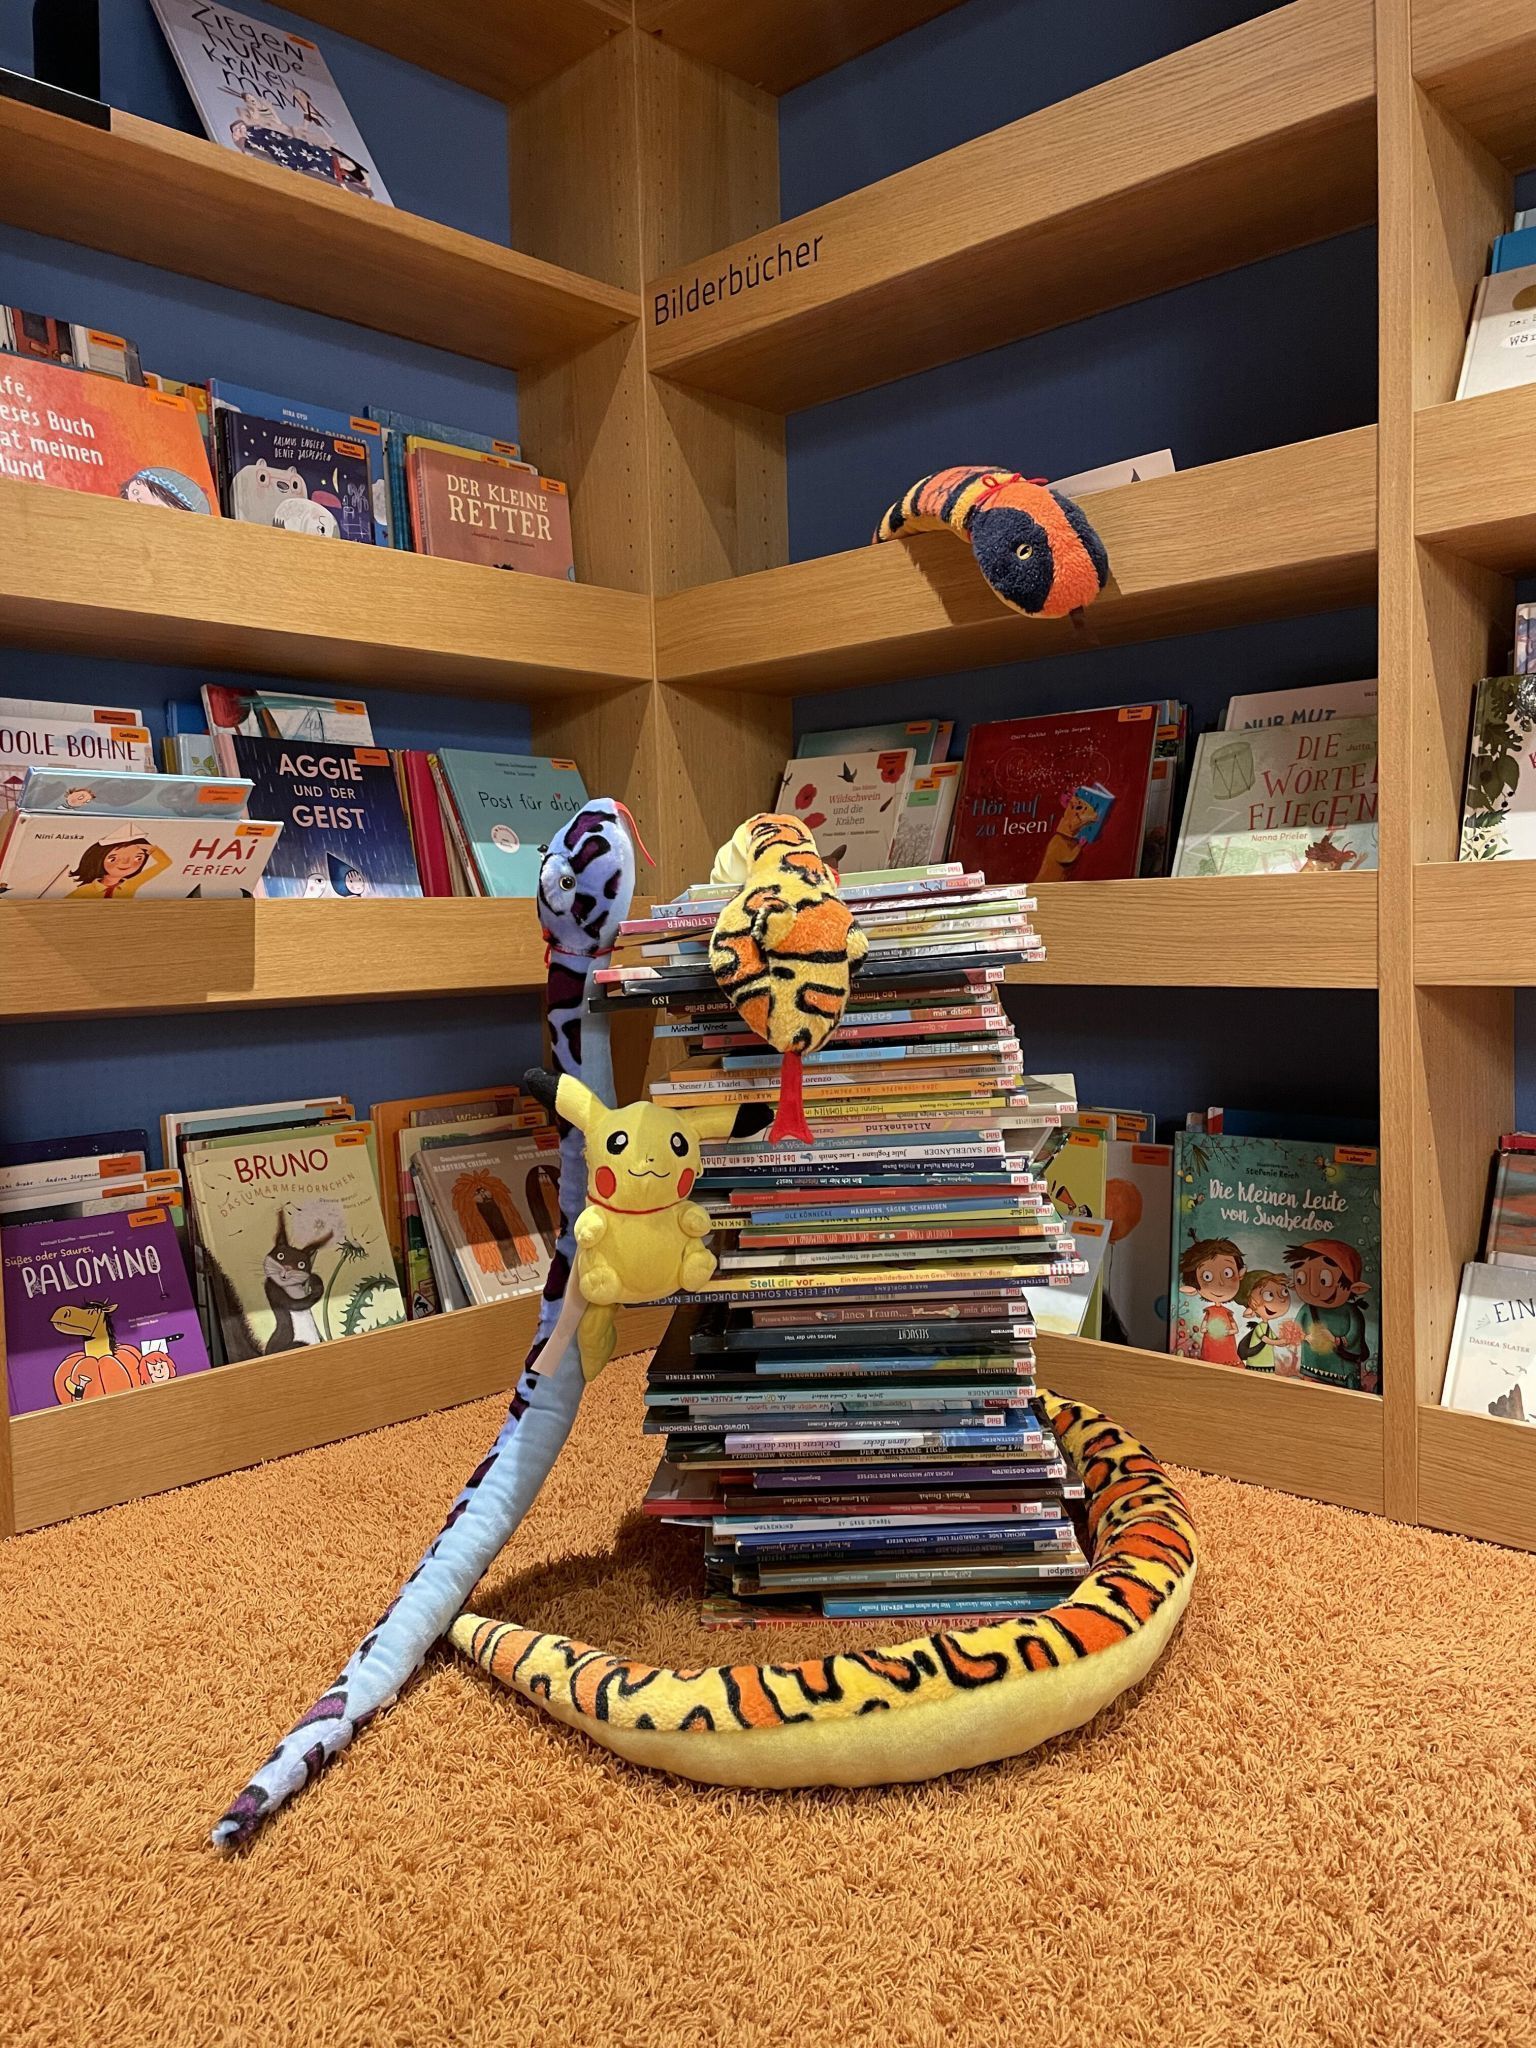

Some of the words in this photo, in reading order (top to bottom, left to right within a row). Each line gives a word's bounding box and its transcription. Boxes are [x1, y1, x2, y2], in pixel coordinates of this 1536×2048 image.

[655, 234, 824, 326] Bilderbücher
[47, 410, 96, 439] Buch
[0, 429, 23, 450] at
[30, 436, 104, 466] meinen
[273, 434, 297, 448] RASMUS
[301, 437, 326, 451] ENGLER
[297, 447, 333, 463] JASPERSEN
[446, 473, 481, 498] DER
[487, 483, 549, 513] KLEINE
[448, 493, 553, 542] RETTER
[1290, 708, 1336, 726] MUT
[66, 733, 142, 762] BOHNE
[1297, 733, 1342, 761] DIE
[278, 752, 364, 782] AGGIE
[292, 783, 324, 798] UND
[329, 785, 357, 800] DER
[478, 791, 514, 810] Post
[519, 792, 543, 811] für
[550, 792, 581, 812] dich
[828, 792, 881, 805] Wildschwein
[832, 804, 850, 815] und
[849, 804, 863, 815] die
[972, 797, 1007, 817] Hör
[1012, 793, 1041, 819] auf
[1247, 791, 1378, 832] FLIEGEN
[291, 804, 365, 831] GEIST
[834, 815, 865, 827] Krähen
[975, 821, 996, 838] zu
[1003, 816, 1056, 836] lesen!
[34, 832, 54, 841] Nini
[55, 832, 85, 842] Alaska
[188, 837, 260, 861] HAi
[182, 864, 249, 878] FERiEN
[882, 989, 898, 999] Leo
[651, 995, 670, 1006] 189
[685, 1003, 705, 1013] Brille
[706, 1002, 729, 1011] seine
[670, 1023, 700, 1034] Michael
[702, 1022, 728, 1032] Wrede
[1011, 1098, 1027, 1107] Bild
[1060, 1105, 1075, 1113] Bild
[1044, 1116, 1060, 1125] Bild
[865, 1121, 932, 1134] Alleinekind
[985, 1131, 1001, 1139] Bild
[891, 1149, 908, 1158] Julie
[923, 1146, 983, 1158] SAUERLÄNDER
[985, 1145, 1001, 1154] Bild
[728, 1156, 741, 1166] ein
[742, 1155, 756, 1166] das
[756, 1153, 781, 1167] Haus,
[783, 1154, 796, 1164] Das
[818, 1153, 838, 1163] Smith
[838, 1152, 855, 1160] Lane
[233, 1147, 328, 1183] BRUNO
[700, 1156, 727, 1168] Zuhau
[1009, 1161, 1025, 1170] Bild
[775, 1178, 793, 1186] Nest?
[829, 1176, 841, 1185] hier
[1013, 1175, 1029, 1184] Bild
[1208, 1178, 1235, 1199] Die
[1237, 1180, 1299, 1207] kleinen
[1302, 1188, 1350, 1213] Leute
[219, 1197, 241, 1219] DAS
[1220, 1206, 1250, 1227] von
[1252, 1204, 1336, 1232] Swabedoo
[1045, 1225, 1060, 1233] Bild
[1058, 1242, 1073, 1251] Bild
[4, 1255, 33, 1268] Süßes
[36, 1250, 58, 1262] oder
[60, 1244, 95, 1257] Saures,
[21, 1245, 161, 1299] PALOMiNO
[750, 1279, 775, 1289] Stell
[777, 1278, 794, 1288] dir
[795, 1278, 814, 1287] vor
[741, 1289, 781, 1301] SOHLEN
[783, 1287, 819, 1298] LEISEN
[821, 1286, 841, 1296] AUF
[684, 1294, 700, 1304] DIE
[704, 1291, 738, 1303] DURCH
[1010, 1305, 1026, 1315] Bild
[897, 1328, 930, 1340] SEESUCHT
[1502, 1341, 1531, 1353] SLATER
[1018, 1388, 1034, 1397] Bild
[680, 1396, 699, 1404] CHINA
[1010, 1398, 1025, 1407] Bild
[987, 1416, 1002, 1426] Bild
[659, 1425, 693, 1433] NASHORN
[723, 1423, 750, 1431] LUDWIG
[862, 1439, 887, 1448] Becker
[887, 1438, 911, 1447] Aaron
[981, 1436, 1023, 1444] GERSTENBERG
[1026, 1434, 1042, 1443] Bild
[741, 1444, 761, 1453] Tiere
[763, 1444, 776, 1453] der
[777, 1442, 801, 1453] Hüter
[802, 1442, 822, 1451] letzte
[823, 1441, 840, 1450] Der
[859, 1448, 875, 1457] DER
[877, 1446, 922, 1456] ACHTSAME
[924, 1445, 948, 1454] TIGER
[856, 1473, 879, 1481] TIEFSEE
[898, 1472, 923, 1480] MISSION
[936, 1470, 955, 1478] FUCHS
[813, 1497, 831, 1505] Glück
[859, 1495, 870, 1503] Als
[1023, 1505, 1039, 1514] Bild
[1043, 1510, 1058, 1519] Bild
[950, 1533, 980, 1541] CHARLOTTE
[1058, 1529, 1072, 1538] Bild
[903, 1535, 928, 1543] MATHIAS
[1047, 1567, 1074, 1577] Südpol
